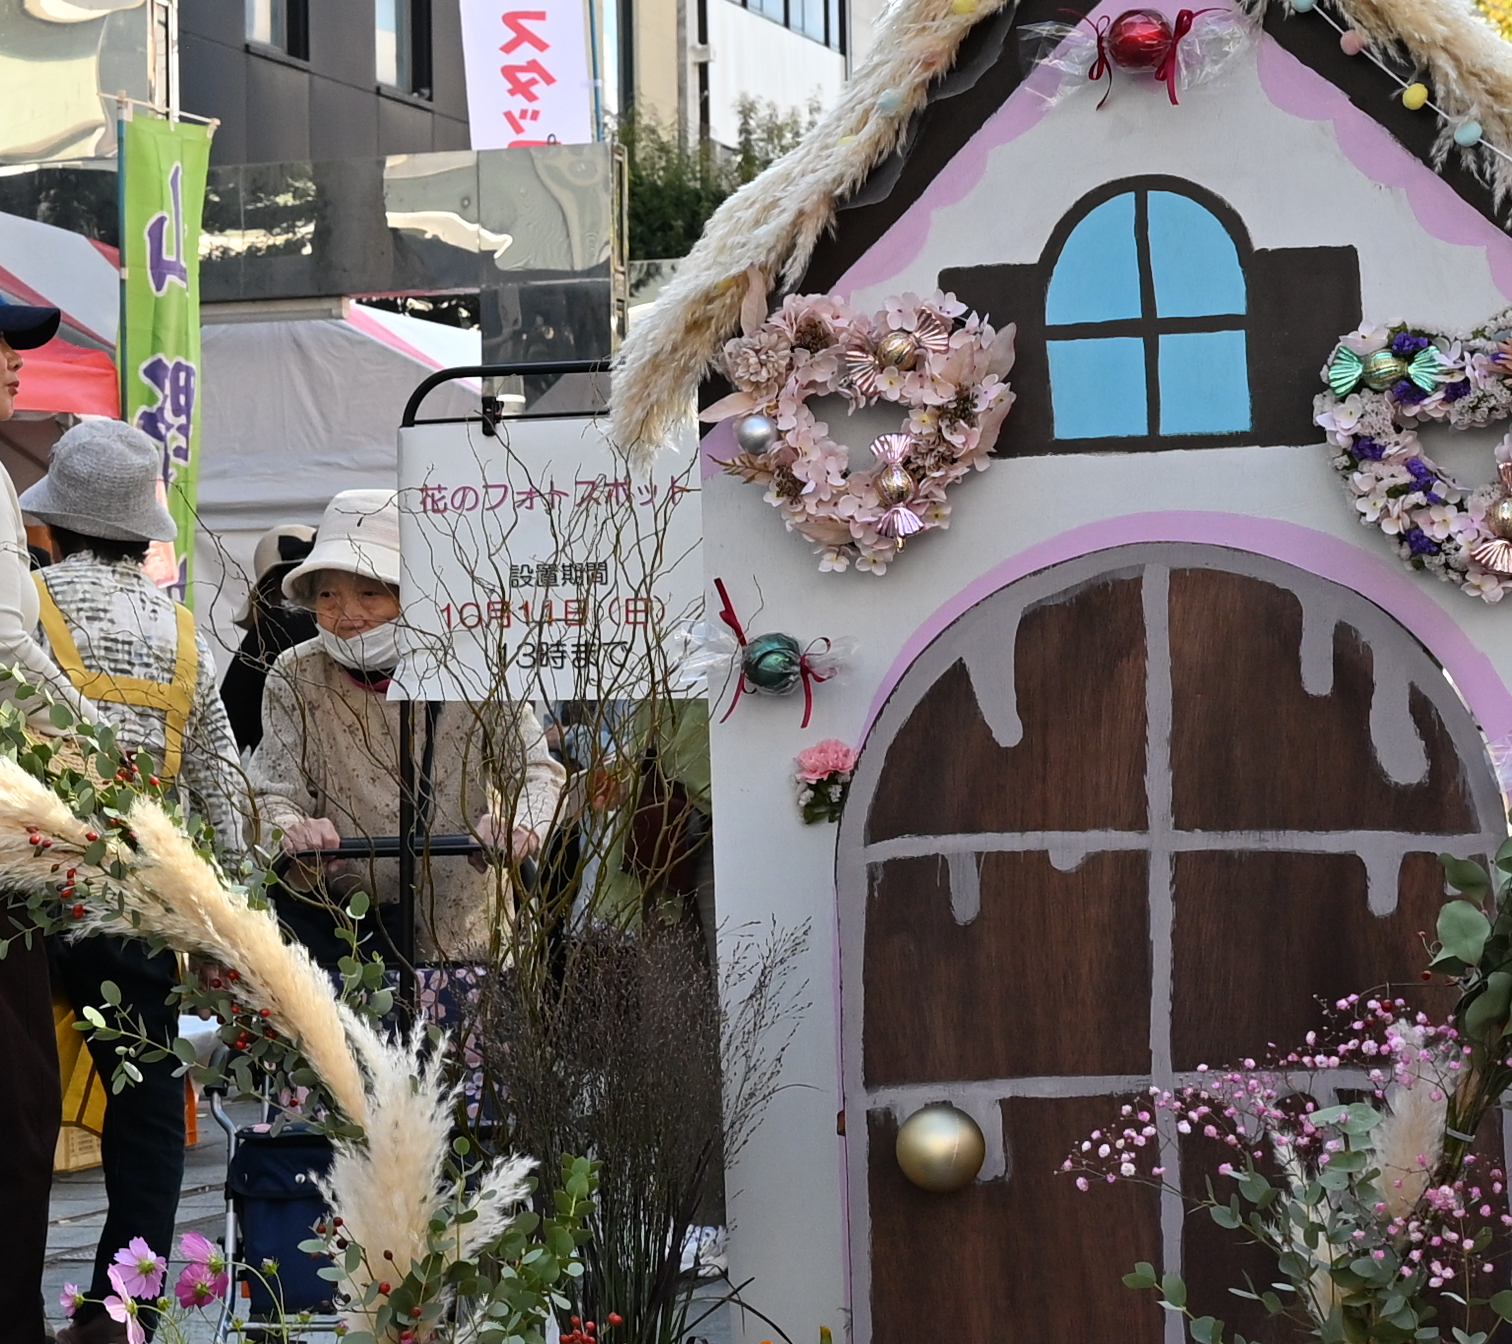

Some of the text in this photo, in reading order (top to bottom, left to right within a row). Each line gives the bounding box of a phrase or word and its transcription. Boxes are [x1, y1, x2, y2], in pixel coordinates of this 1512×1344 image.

[420, 476, 687, 514] 花のフォトスポット
[510, 561, 608, 588] 設置期間
